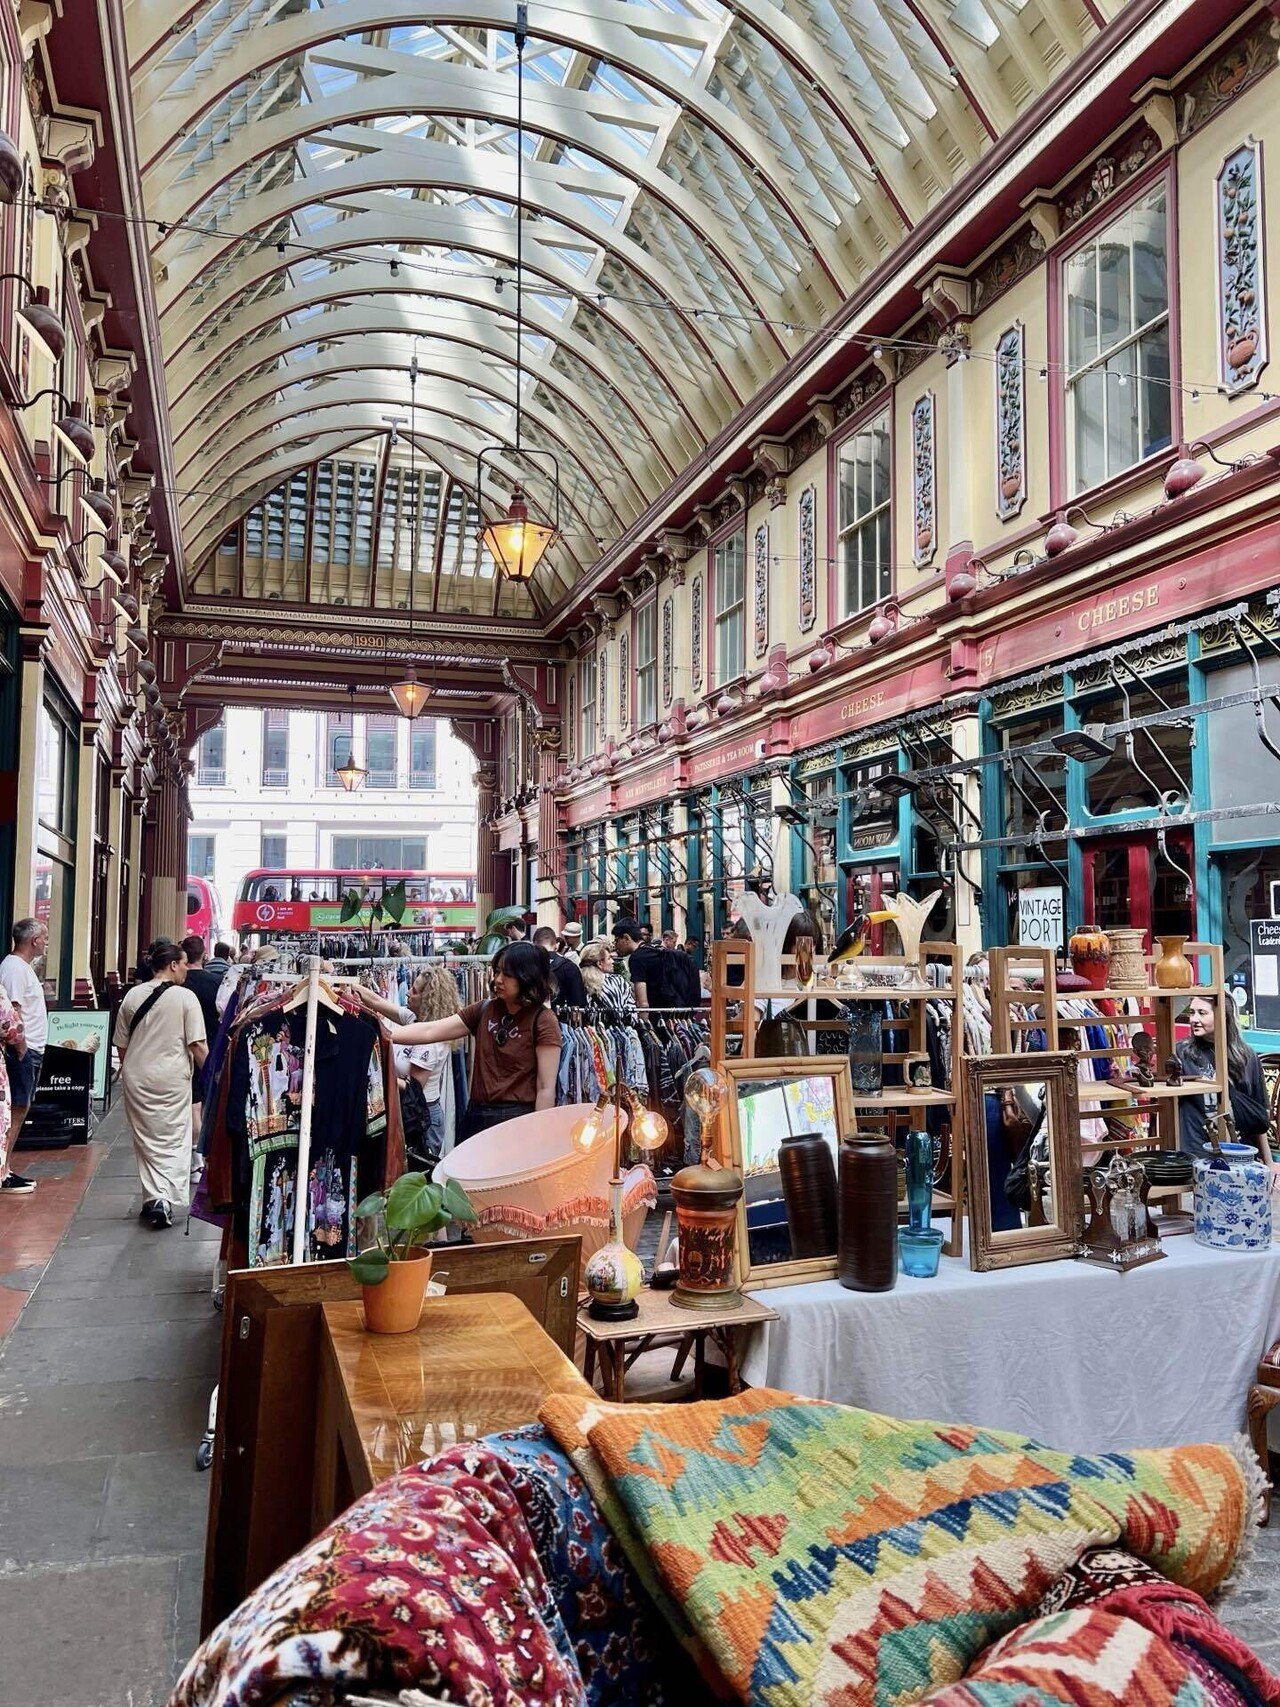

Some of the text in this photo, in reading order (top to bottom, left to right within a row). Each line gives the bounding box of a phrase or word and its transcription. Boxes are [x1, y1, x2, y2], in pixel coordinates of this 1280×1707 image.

[1078, 585, 1160, 631] CHEESE
[355, 635, 384, 648] 1990
[984, 648, 993, 667] 5
[841, 691, 885, 720] CHEESE
[726, 750, 738, 762] TEA
[1020, 898, 1062, 916] VINTAGE
[1021, 918, 1061, 942] PORT
[50, 1075, 71, 1085] free
